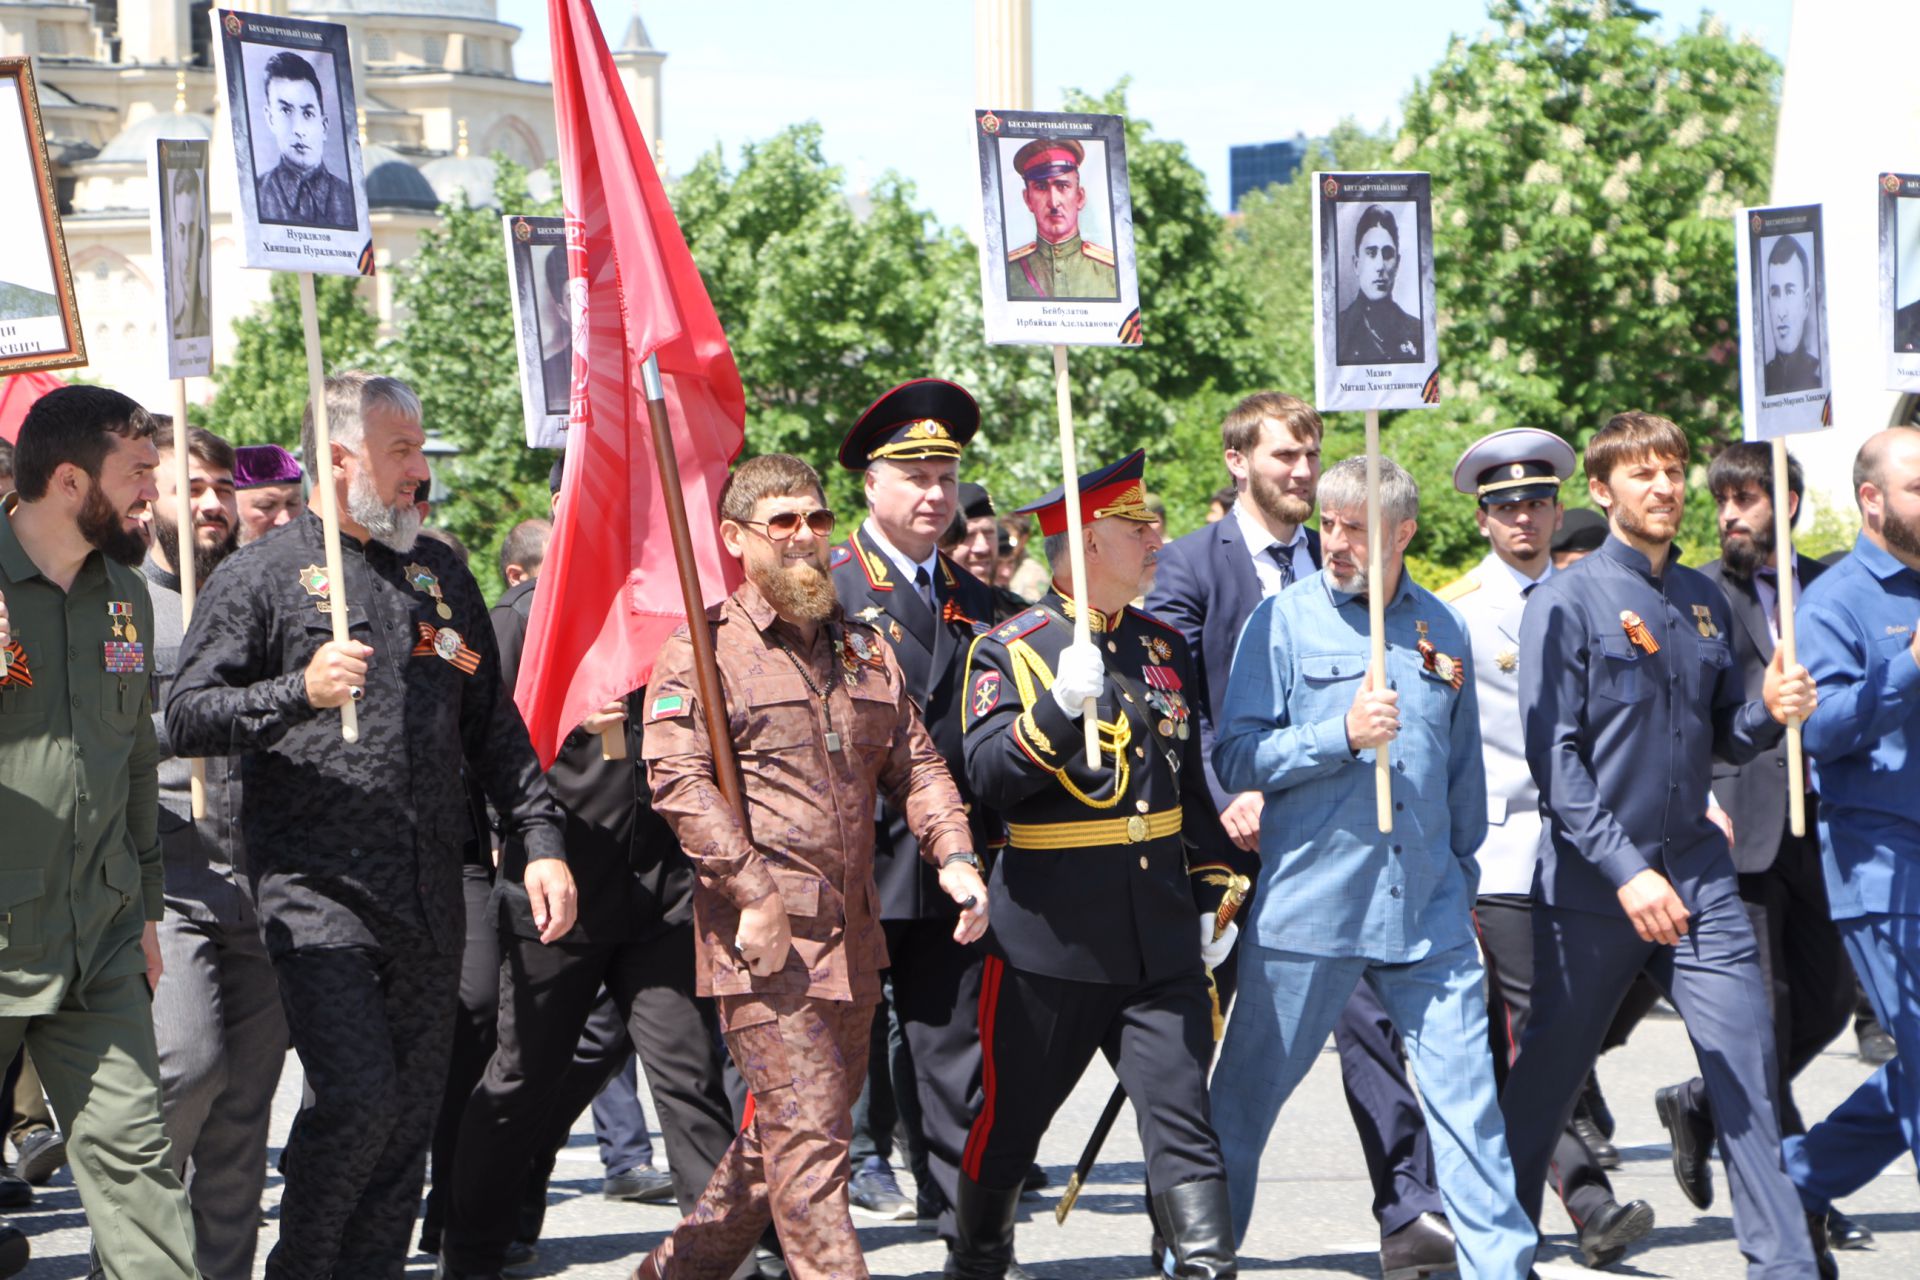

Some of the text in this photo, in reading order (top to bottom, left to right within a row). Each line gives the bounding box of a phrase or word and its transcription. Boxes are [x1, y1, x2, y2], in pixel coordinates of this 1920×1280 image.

[248, 23, 323, 41] БЕССМЕРТНЫЙ ПОЛК
[1007, 120, 1093, 130] БЕССМЕРТНЫЙ ПОЛК
[286, 228, 331, 242] Нурадилов
[263, 241, 358, 258] Ханпаша Нурадилович
[1042, 306, 1089, 317] Бейбулатов
[1016, 318, 1119, 329] Ирбайхан Адельханович
[1366, 368, 1393, 378] Мазаев
